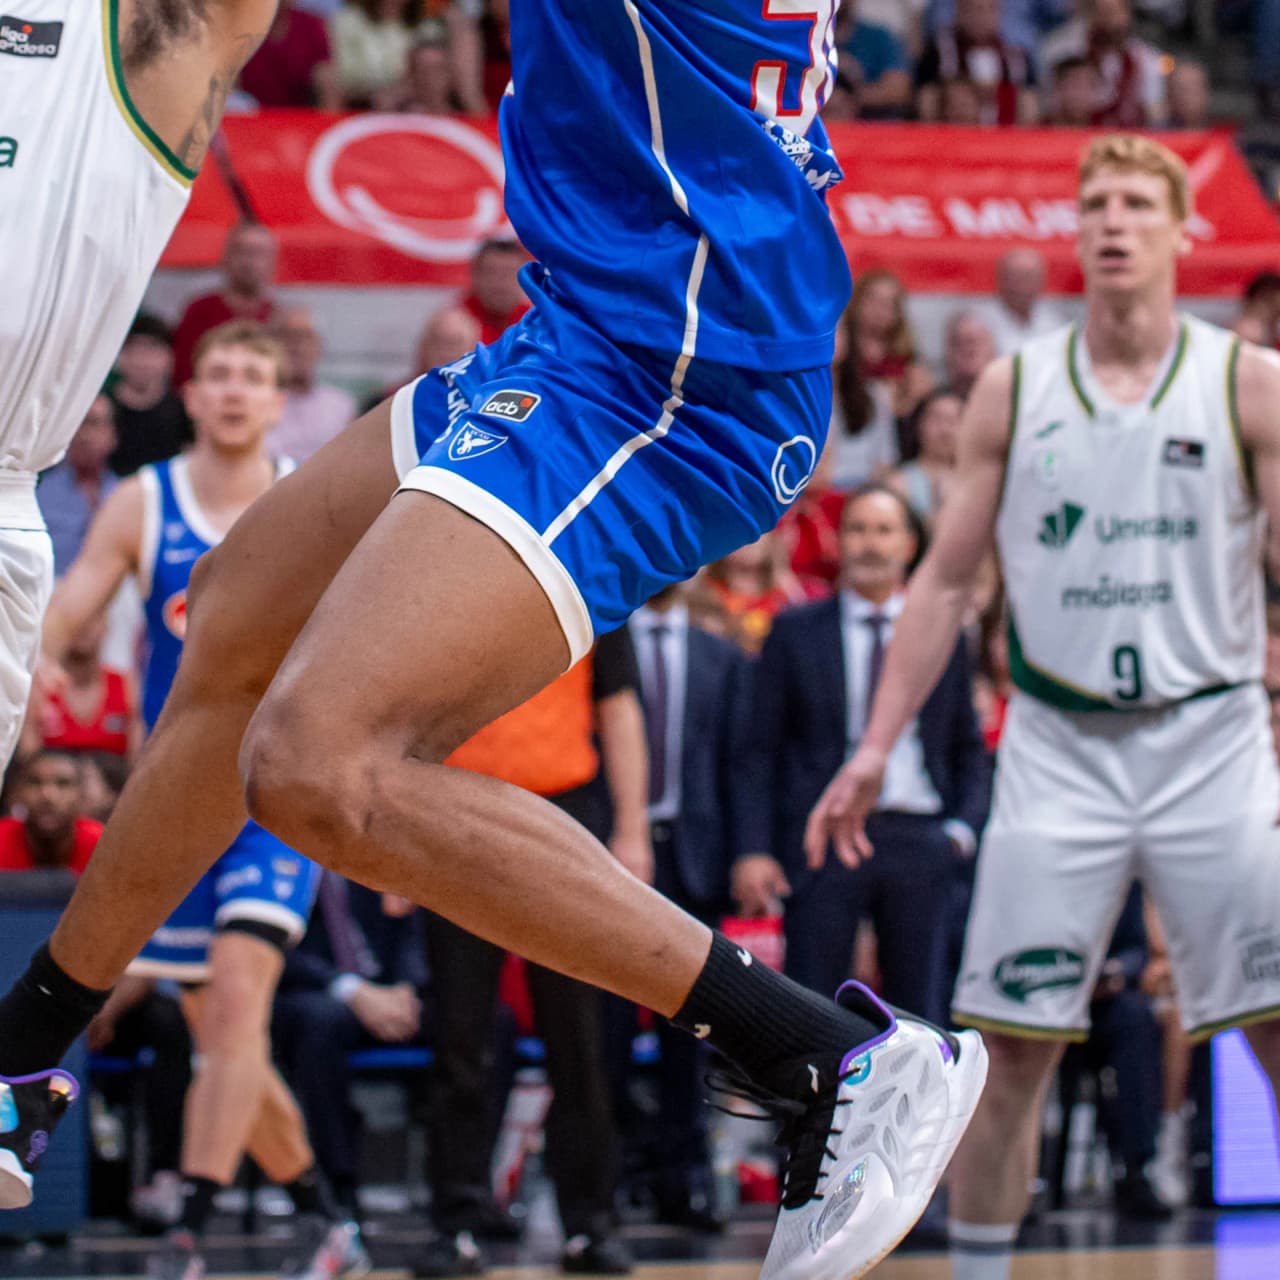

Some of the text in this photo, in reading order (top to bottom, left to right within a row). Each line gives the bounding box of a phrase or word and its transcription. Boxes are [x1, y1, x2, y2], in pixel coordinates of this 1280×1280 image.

[0, 25, 28, 42] liga
[485, 400, 519, 416] acb
[1095, 515, 1198, 546] Unicaja
[1113, 643, 1142, 701] 9
